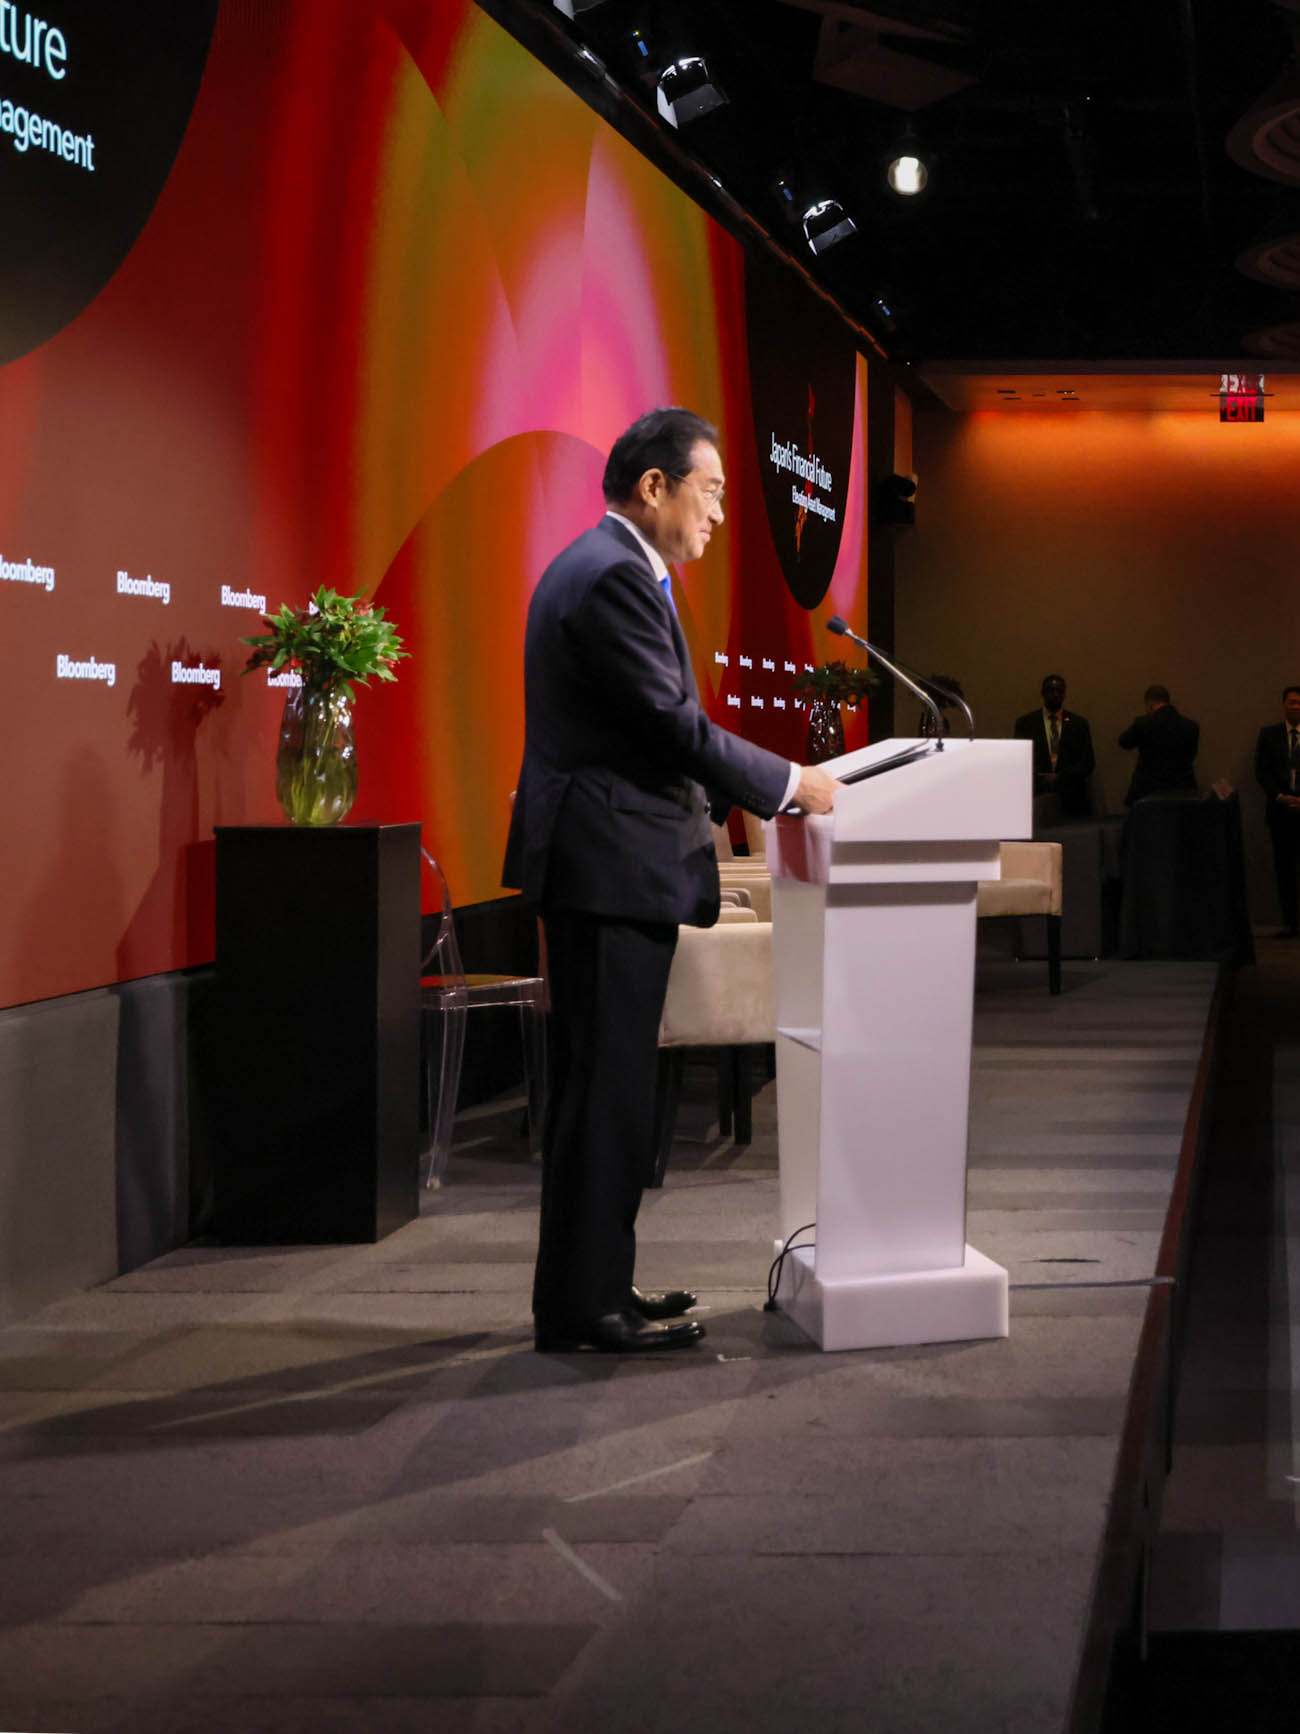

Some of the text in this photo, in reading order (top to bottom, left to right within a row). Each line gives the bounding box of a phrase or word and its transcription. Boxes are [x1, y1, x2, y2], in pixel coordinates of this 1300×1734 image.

[0, 98, 95, 171] agement
[1226, 396, 1258, 421] EXIT
[117, 571, 171, 605] Bloomberg
[221, 586, 267, 616] Bloomberg
[56, 654, 116, 686] Bloomberg
[171, 661, 221, 690] Bloomberg
